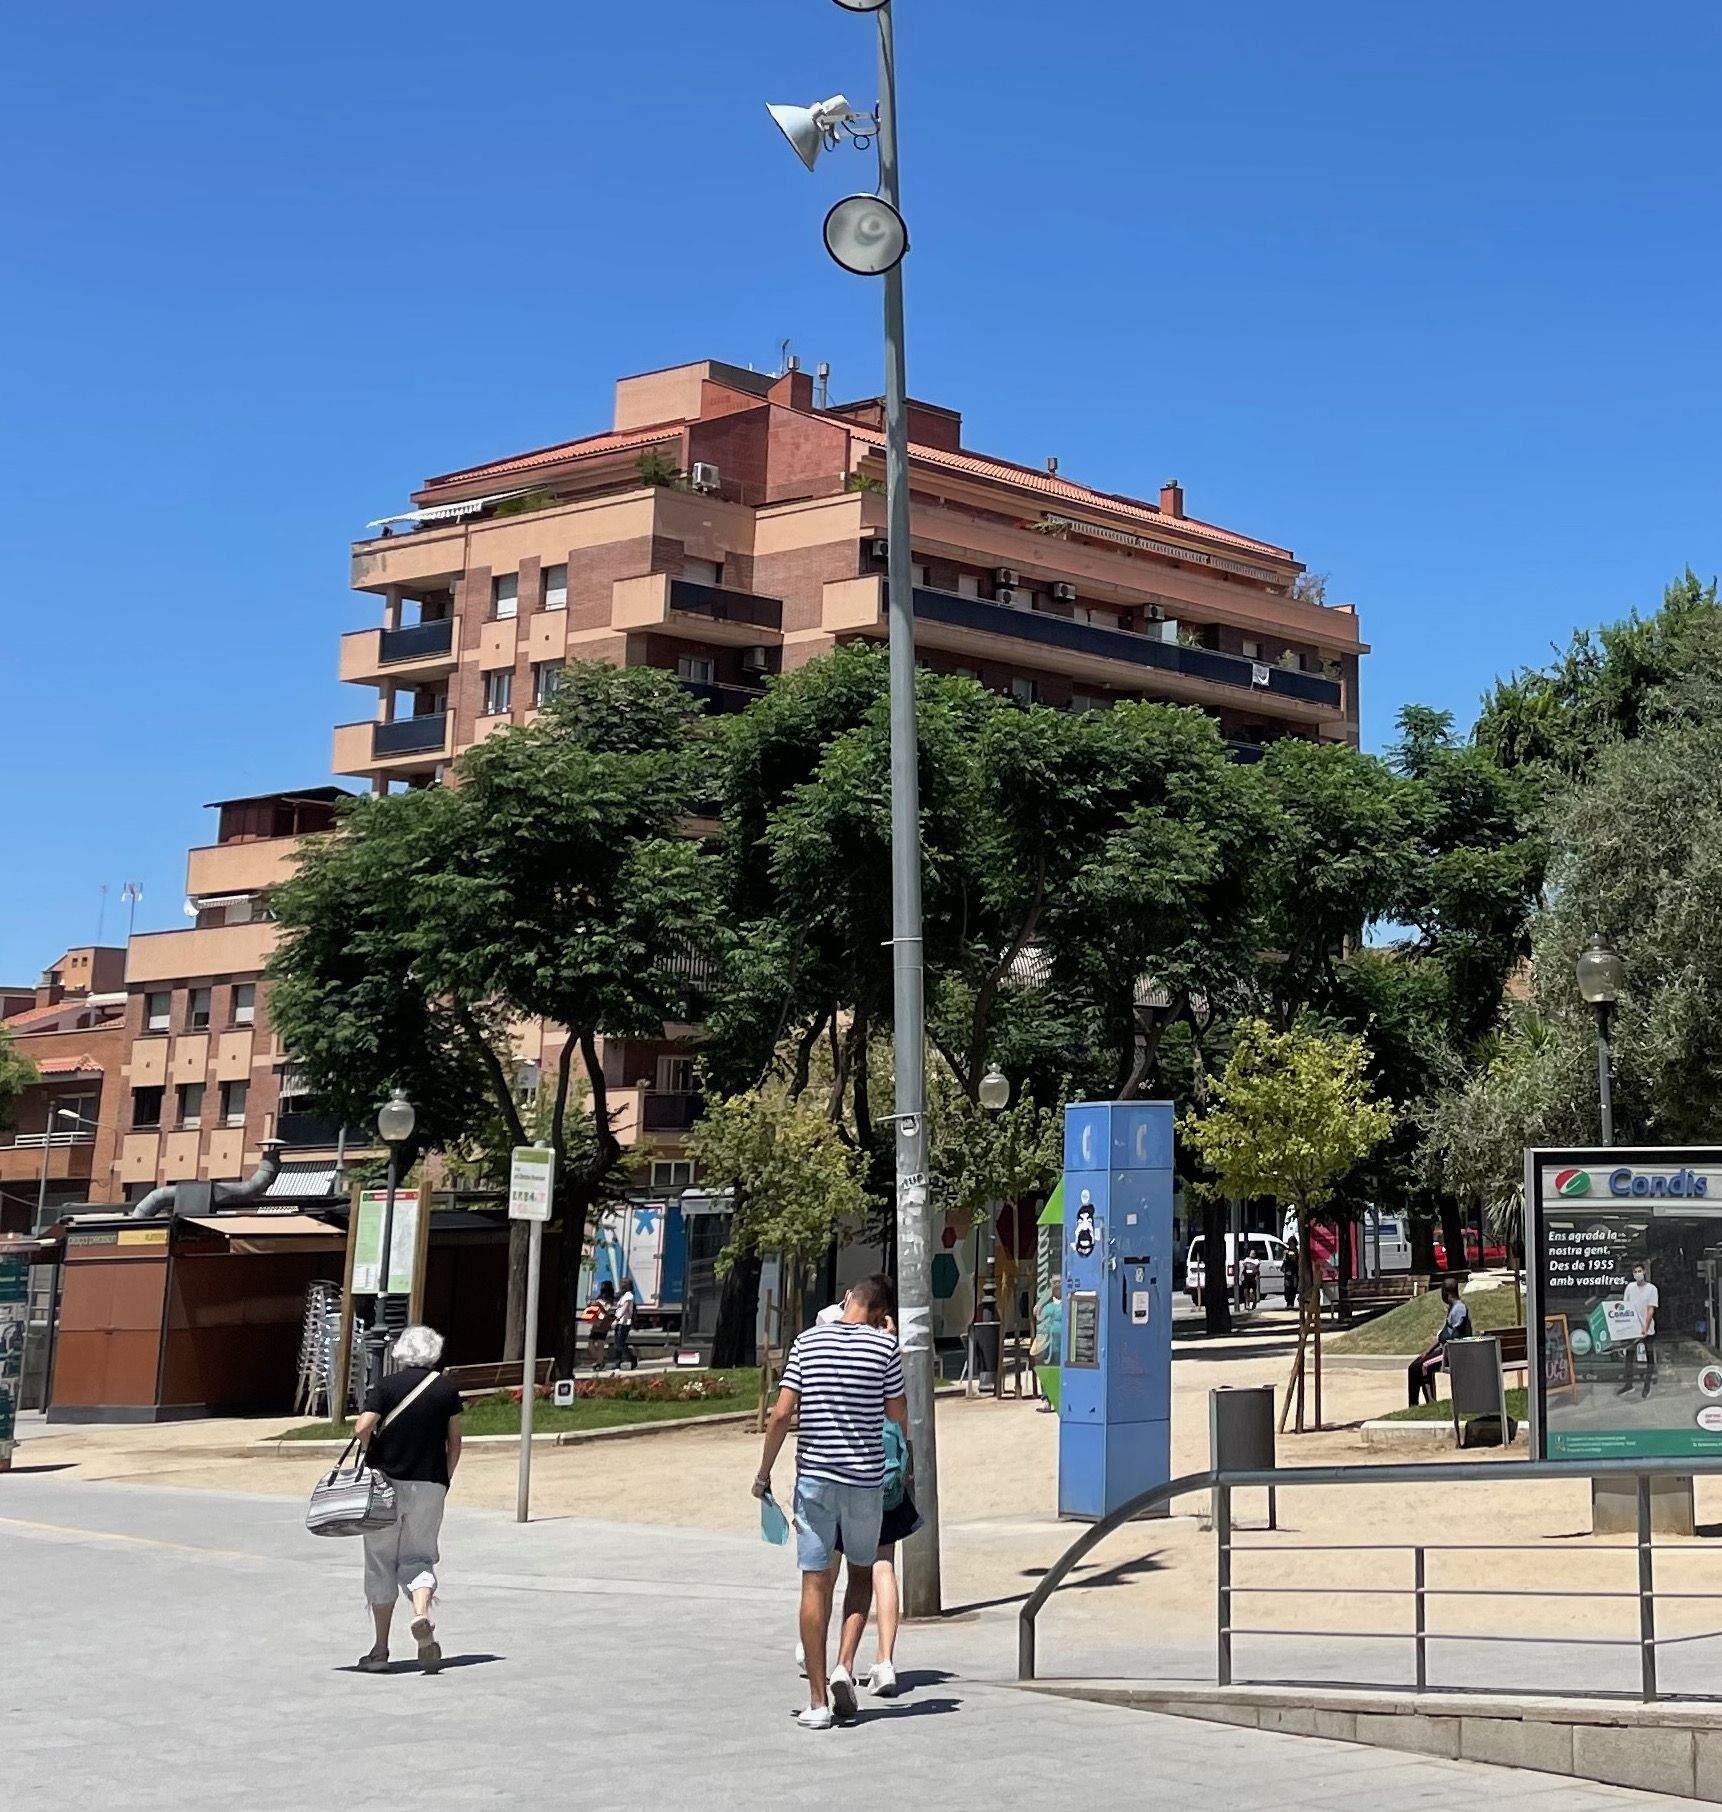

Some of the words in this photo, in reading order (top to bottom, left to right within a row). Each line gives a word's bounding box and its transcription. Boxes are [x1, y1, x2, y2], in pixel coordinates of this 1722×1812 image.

[1609, 1168, 1708, 1198] Condis
[1548, 1231, 1567, 1241] Ens
[1568, 1230, 1606, 1243] agrada
[1607, 1230, 1618, 1240] la
[1548, 1246, 1583, 1256] nostra
[1584, 1246, 1611, 1258] gent.
[1549, 1260, 1570, 1271] Des
[1571, 1260, 1586, 1271] de
[1588, 1260, 1615, 1270] 1955
[1549, 1275, 1575, 1286] amb
[1576, 1275, 1629, 1286] vosaltres.
